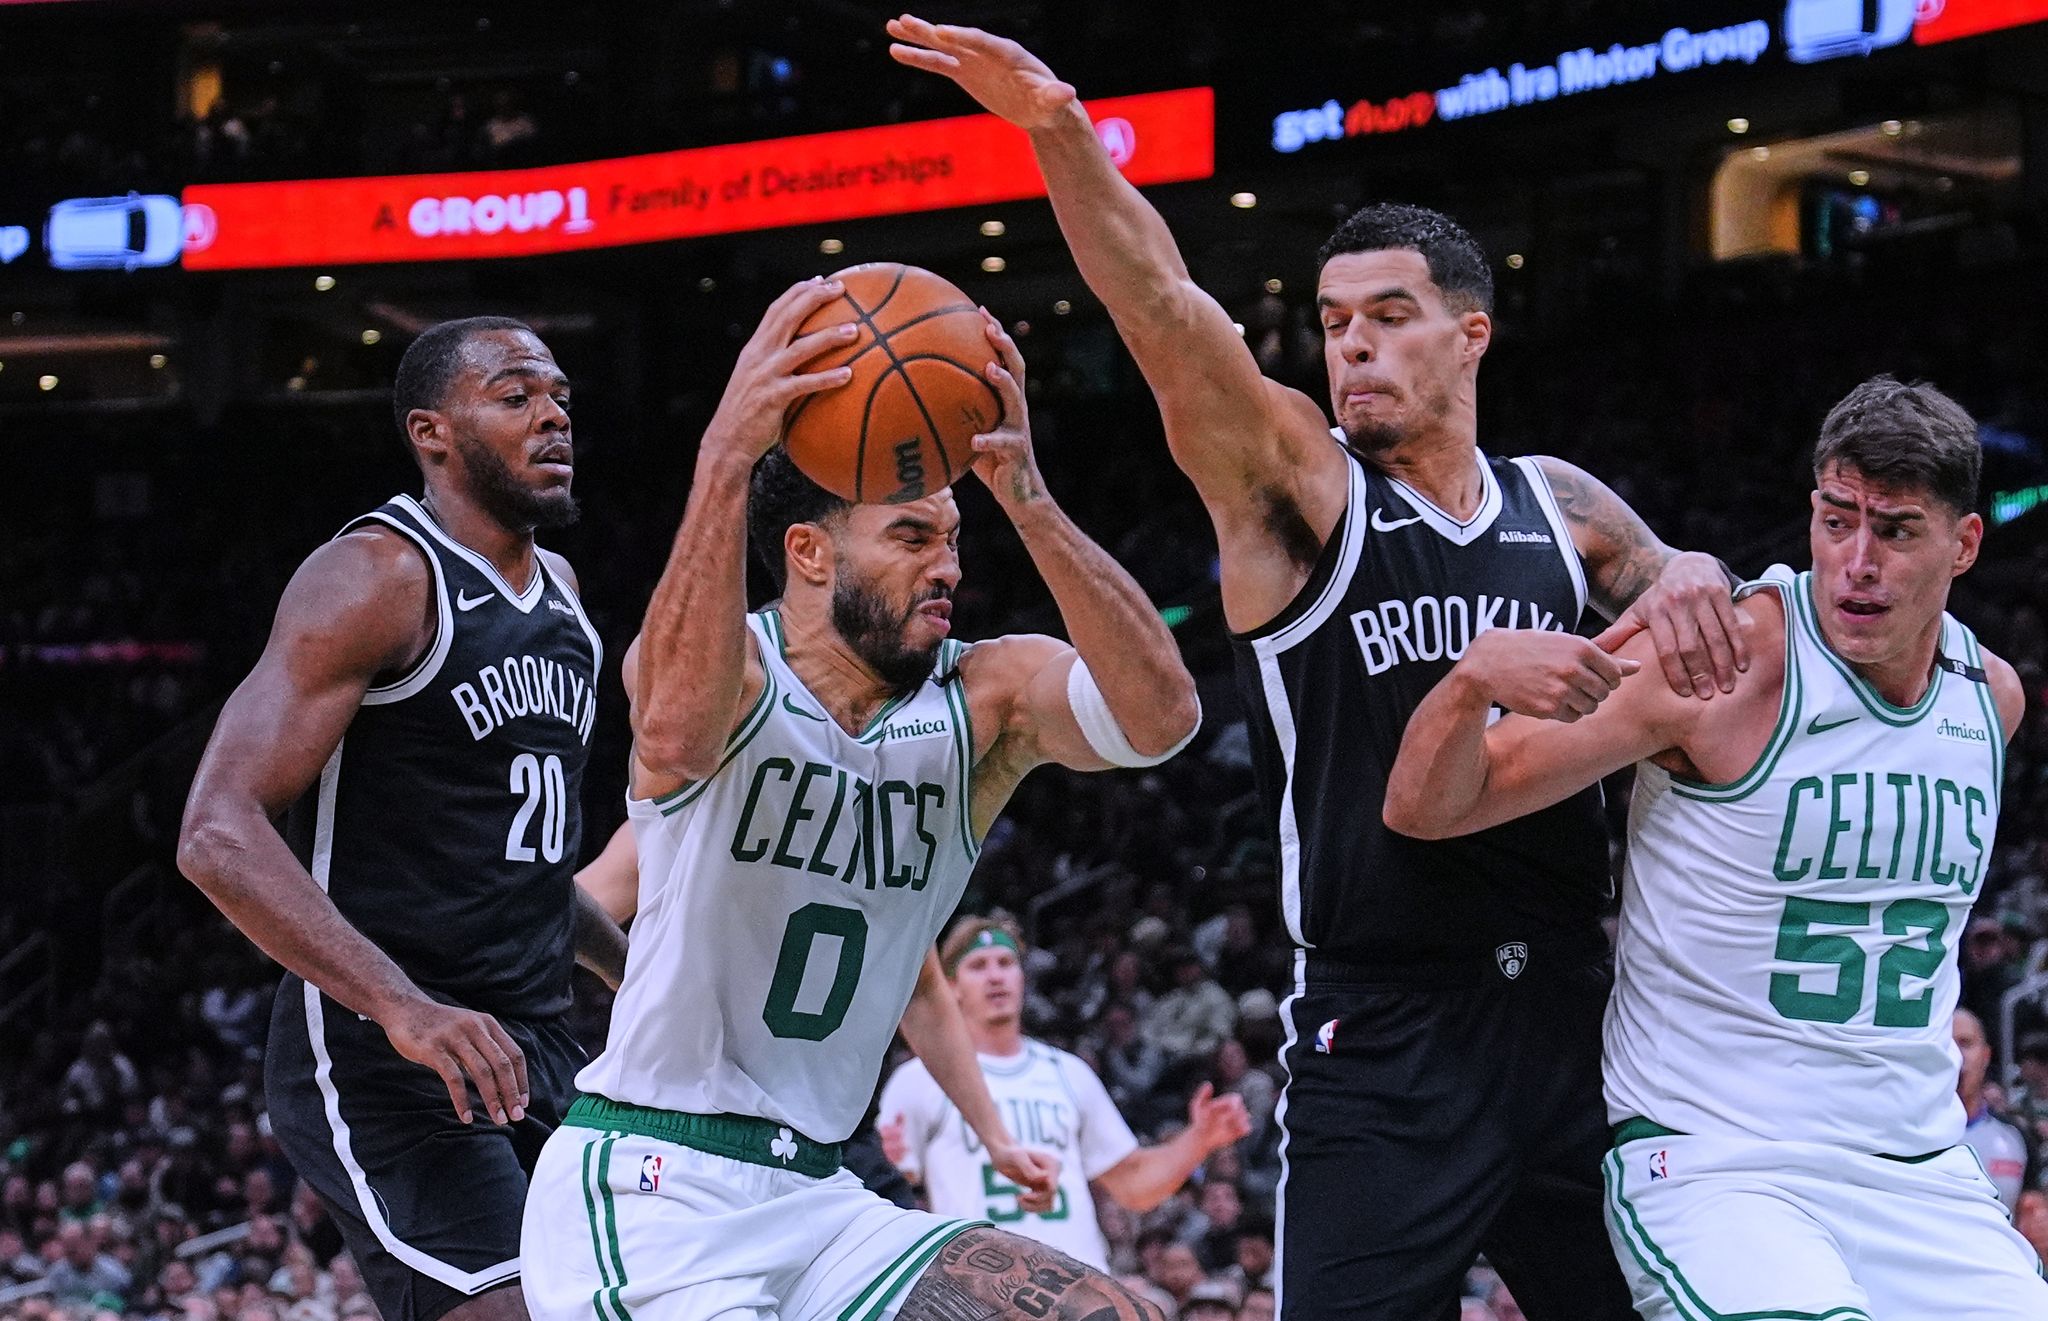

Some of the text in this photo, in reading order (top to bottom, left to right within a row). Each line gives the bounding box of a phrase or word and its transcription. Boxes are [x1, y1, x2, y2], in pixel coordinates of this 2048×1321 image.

[1436, 67, 1509, 121] with
[1508, 62, 1559, 106] Ira
[1557, 46, 1661, 95] Motor
[1660, 19, 1770, 72] Group
[372, 203, 395, 231] A
[609, 175, 711, 213] Family
[720, 171, 750, 201] of
[759, 153, 954, 197] Dealerships
[1499, 530, 1551, 544] Alibaba
[1350, 595, 1564, 676] BROOK
[451, 655, 597, 746] BROOKLYN
[880, 719, 946, 743] Amica
[1937, 718, 1987, 741] Amica
[505, 753, 566, 864] 20
[1773, 772, 1986, 895] CELTICS
[762, 902, 868, 1042] 0
[1500, 945, 1525, 962] NETS
[1769, 895, 1950, 1027] 52
